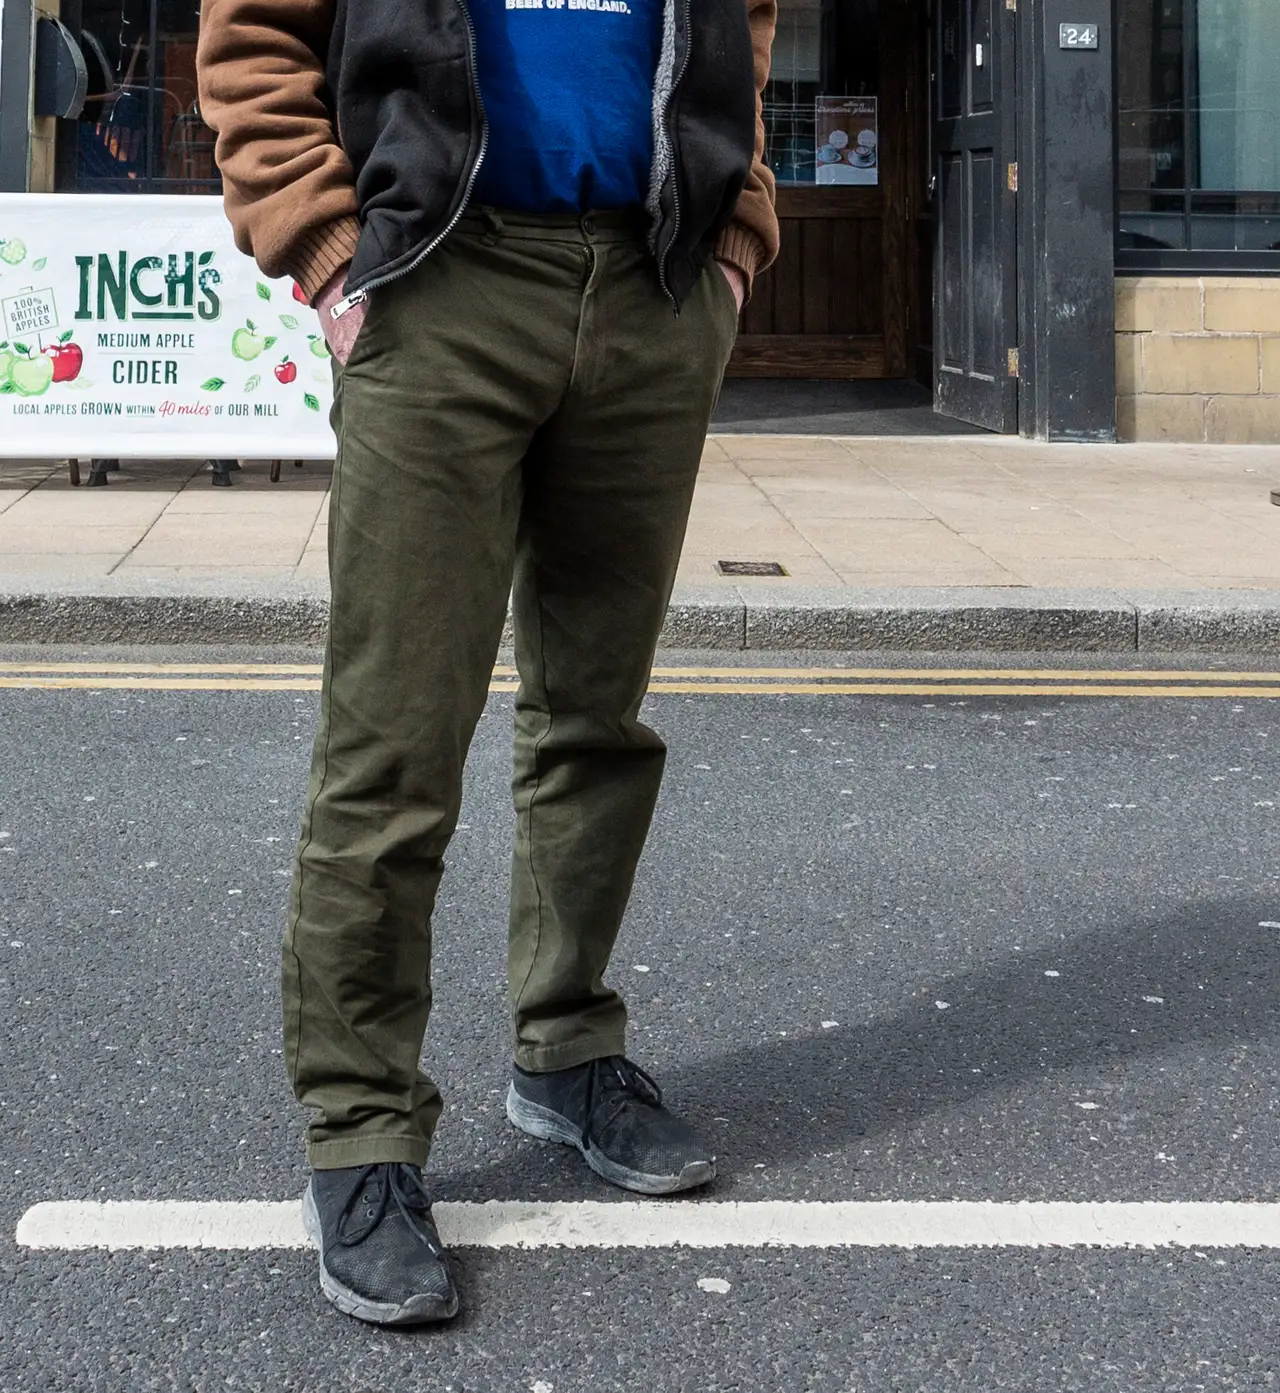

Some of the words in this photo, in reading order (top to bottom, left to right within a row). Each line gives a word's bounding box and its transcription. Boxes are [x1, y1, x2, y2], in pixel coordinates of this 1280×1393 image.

[1066, 28, 1091, 44] 24
[14, 297, 42, 311] 100%
[10, 305, 50, 323] BRITISH
[15, 315, 51, 332] APPLES
[98, 333, 151, 348] MEDIUM
[156, 333, 195, 348] APPLE
[112, 360, 178, 384] CIDER
[13, 403, 40, 415] LOCAL
[44, 403, 77, 415] APPLES
[81, 402, 122, 415] GROWN
[126, 405, 155, 415] WITHIN
[159, 401, 175, 417] 40
[177, 401, 211, 416] miles
[214, 405, 224, 415] OF
[228, 403, 249, 416] OUR
[254, 403, 279, 417] MILL
